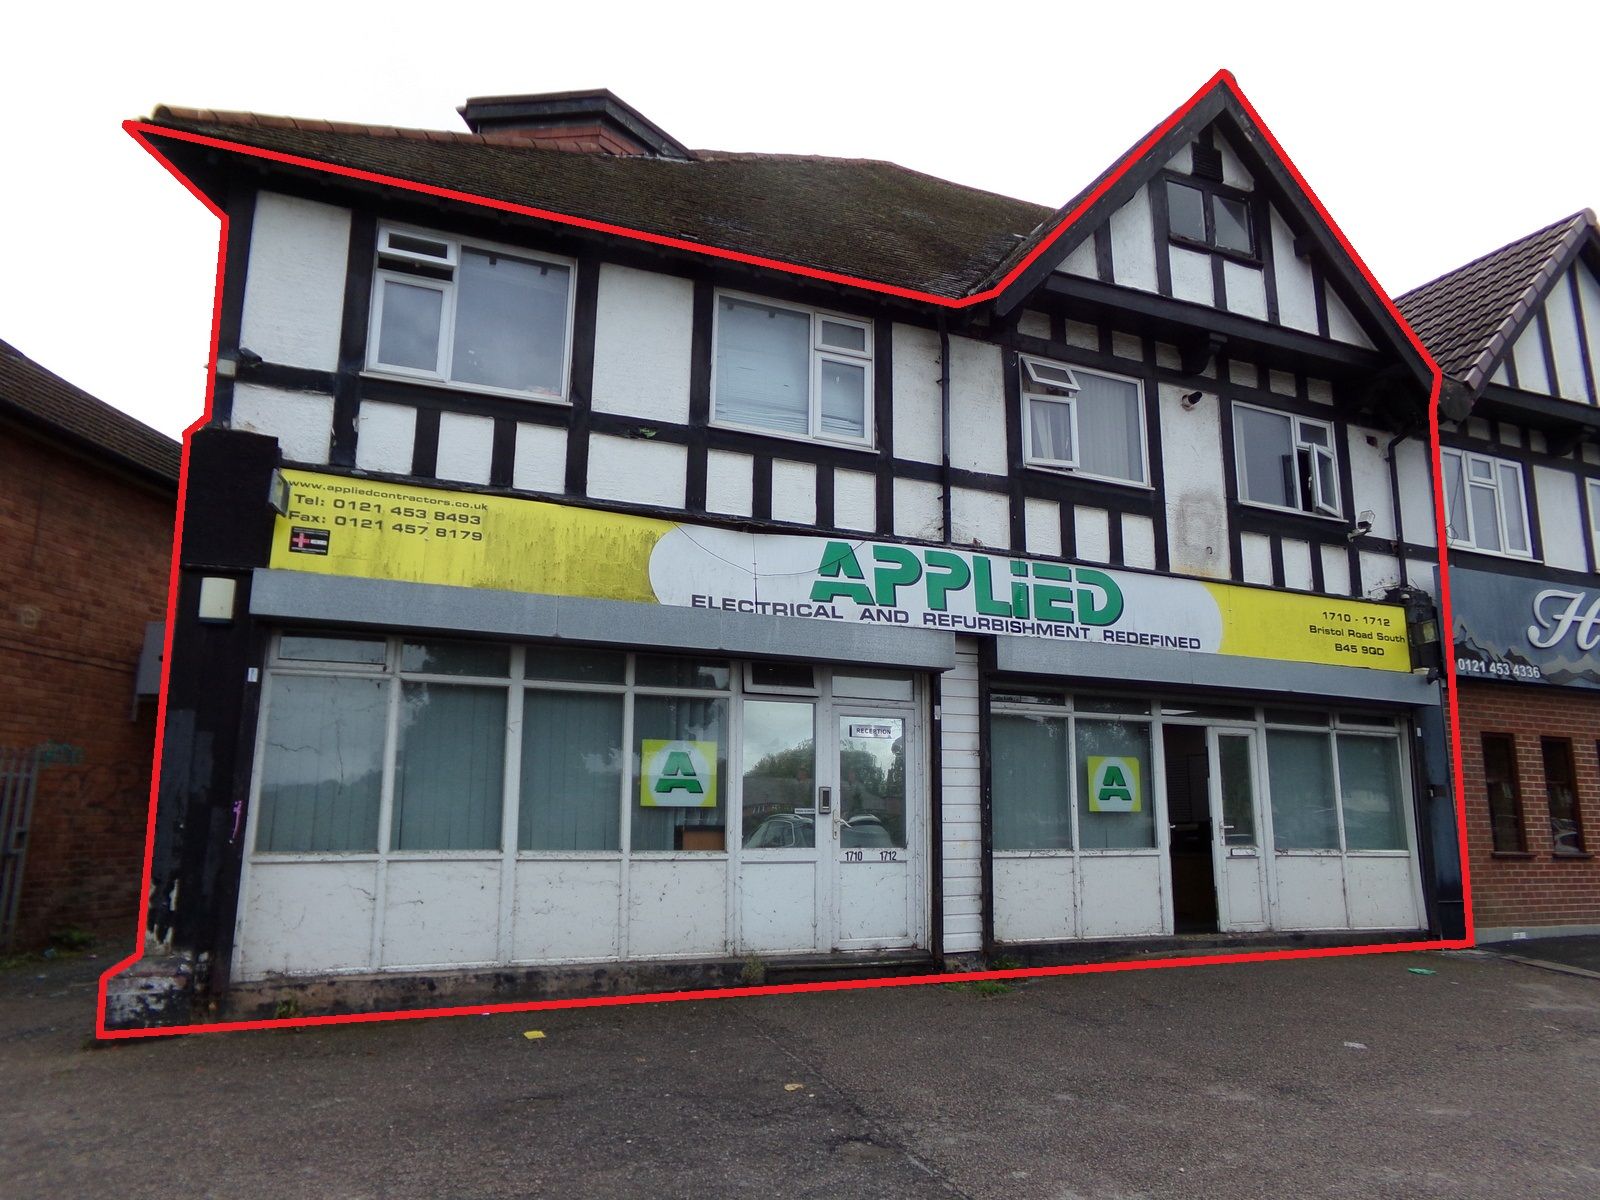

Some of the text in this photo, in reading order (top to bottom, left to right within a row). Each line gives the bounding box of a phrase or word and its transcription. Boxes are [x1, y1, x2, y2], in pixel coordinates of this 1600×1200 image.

[289, 480, 488, 511] www.appliedcontractors.co.uk
[294, 494, 481, 525] Tel: 0121 453 8493
[289, 510, 483, 541] Fax: 0121 457 8179
[691, 594, 1201, 650] ELECTRICAL AND REFURBISHMENT REDEFINED
[1322, 611, 1352, 623] 1710
[1363, 616, 1391, 627] 1712
[1309, 625, 1406, 643] Bristol Road South
[1335, 643, 1358, 653] B45
[1458, 658, 1541, 679] 0121 453 4336
[856, 727, 891, 735] RECEPTION
[655, 751, 704, 794] A
[1098, 766, 1132, 801] A
[844, 851, 897, 862] 1710 1712
